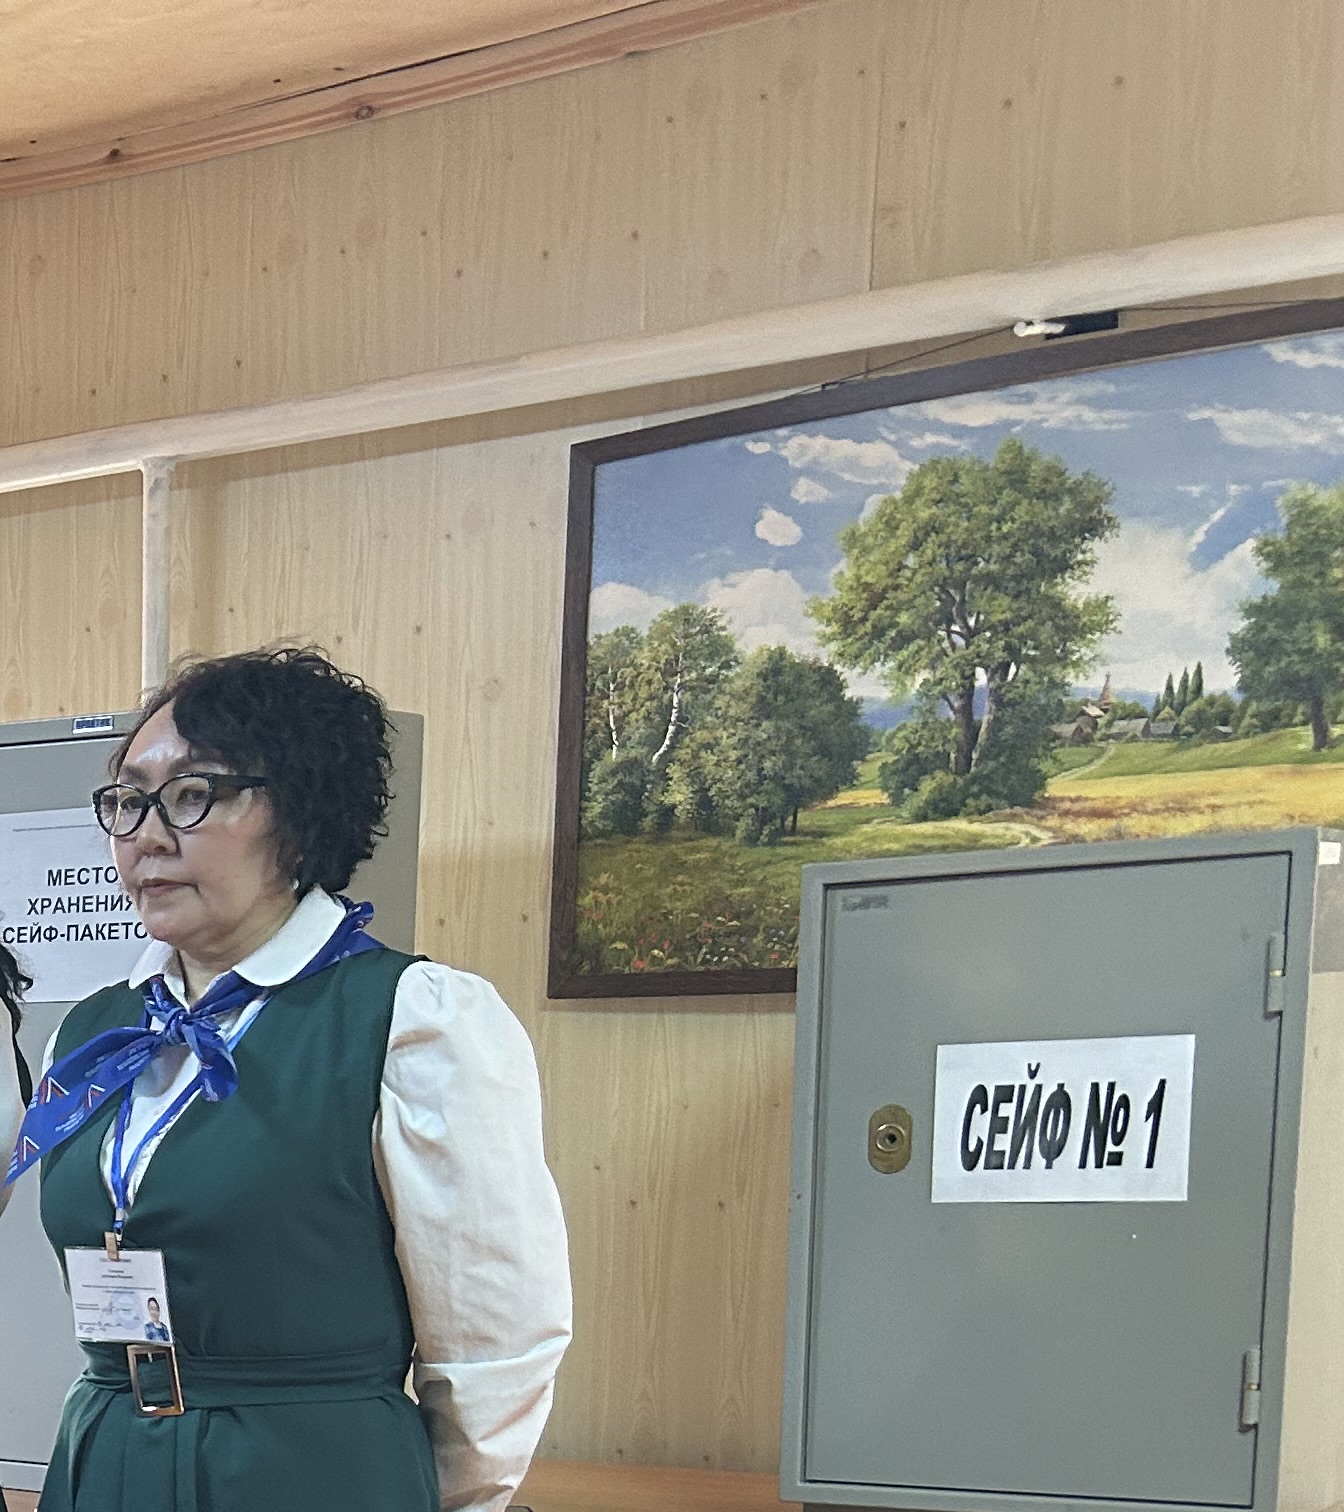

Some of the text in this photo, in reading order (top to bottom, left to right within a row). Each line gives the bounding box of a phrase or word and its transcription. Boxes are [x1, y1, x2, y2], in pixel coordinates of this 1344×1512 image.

[47, 865, 118, 887] МЕСТО
[2, 921, 148, 944] СЕЙФ-ПАКЕТО
[960, 1062, 1167, 1172] СЕЙФ № 1
